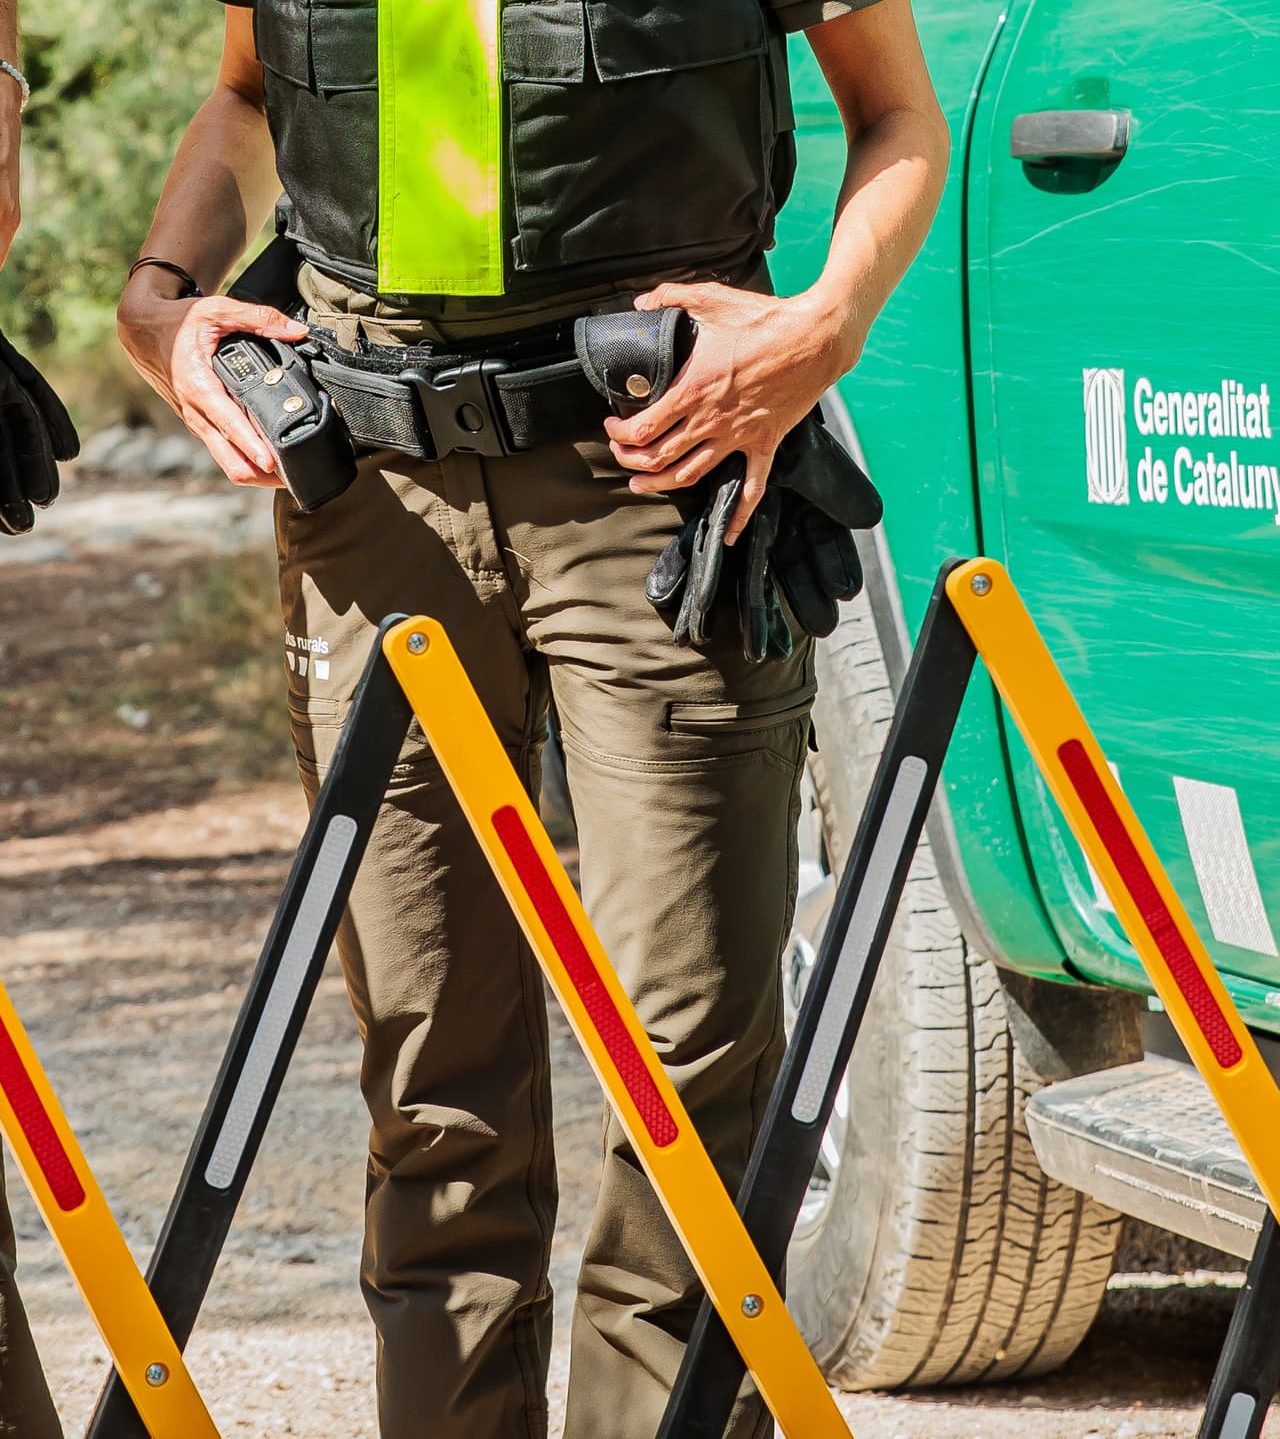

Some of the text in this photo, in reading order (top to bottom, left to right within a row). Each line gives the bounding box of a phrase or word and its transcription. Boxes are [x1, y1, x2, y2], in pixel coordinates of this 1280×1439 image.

[1133, 377, 1272, 439] Generalitat
[1137, 446, 1168, 504] de
[296, 636, 329, 654] rurals
[812, 836, 868, 870] agents rurals
